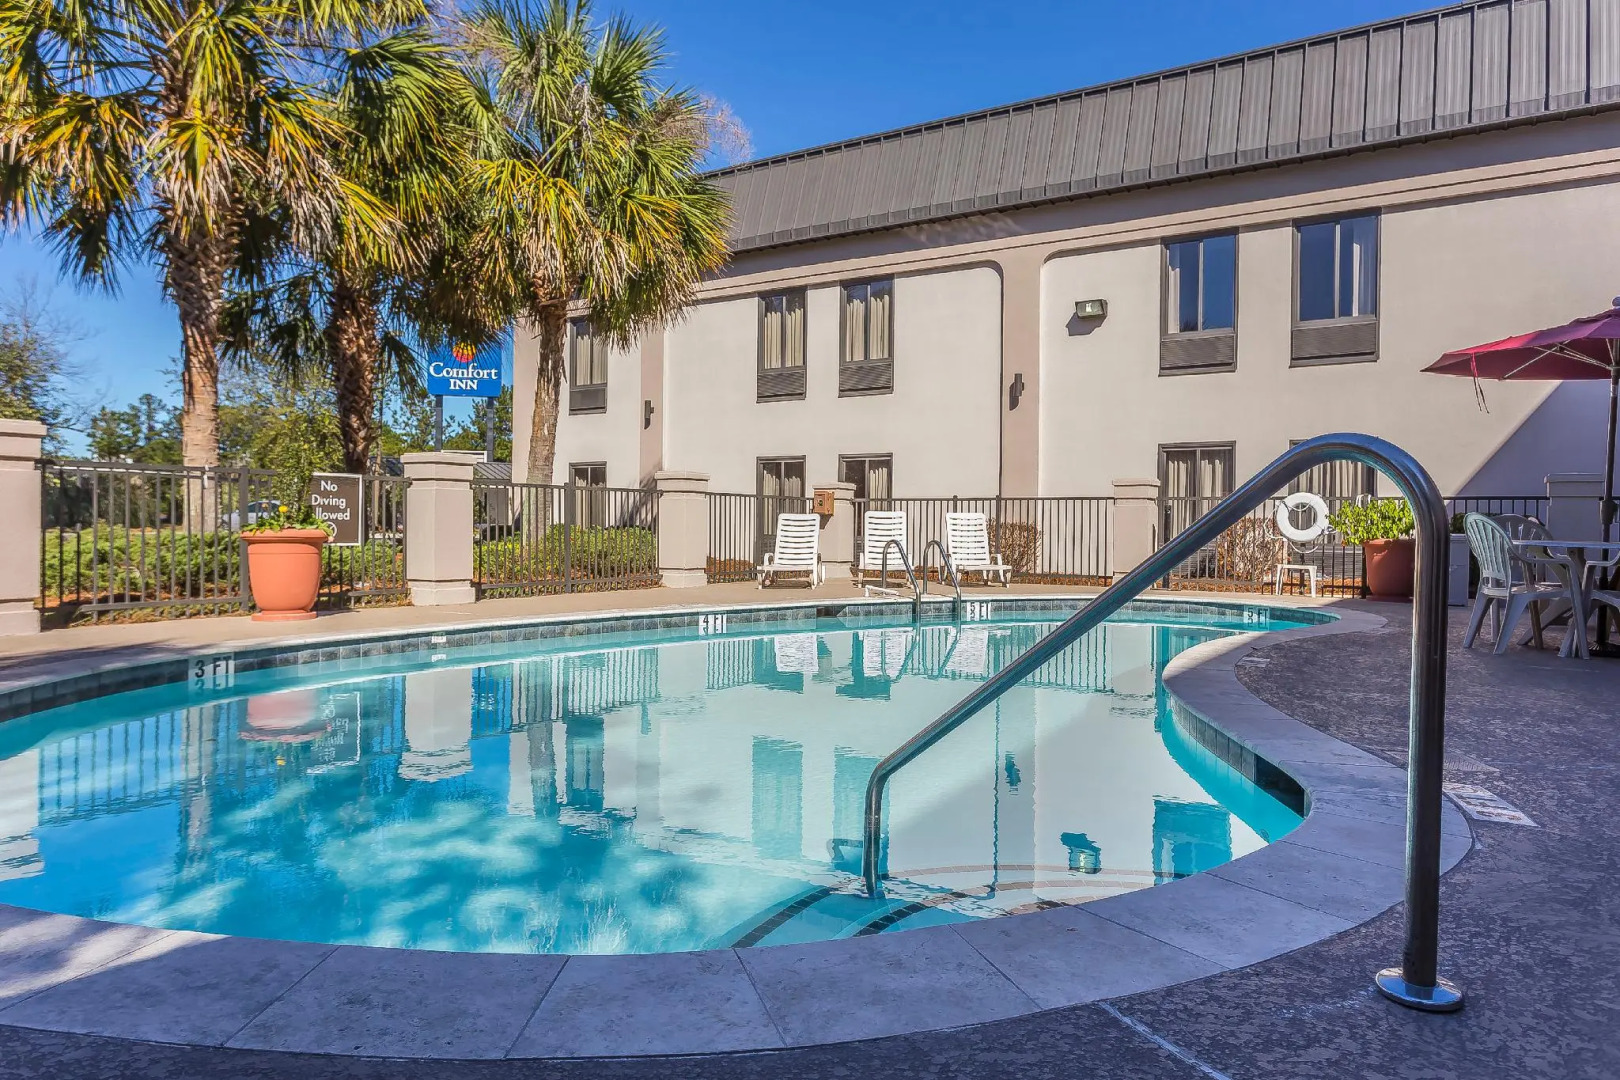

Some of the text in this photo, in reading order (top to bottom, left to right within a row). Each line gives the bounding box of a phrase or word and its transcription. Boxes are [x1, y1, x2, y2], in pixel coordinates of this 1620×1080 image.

[429, 362, 498, 379] Comfort
[449, 379, 478, 390] INN
[321, 480, 338, 491] No
[311, 494, 346, 509] Diving
[314, 507, 350, 520] llowed
[703, 613, 709, 625] 4
[1247, 607, 1269, 619] 5 FT
[195, 656, 231, 678] 3 FT
